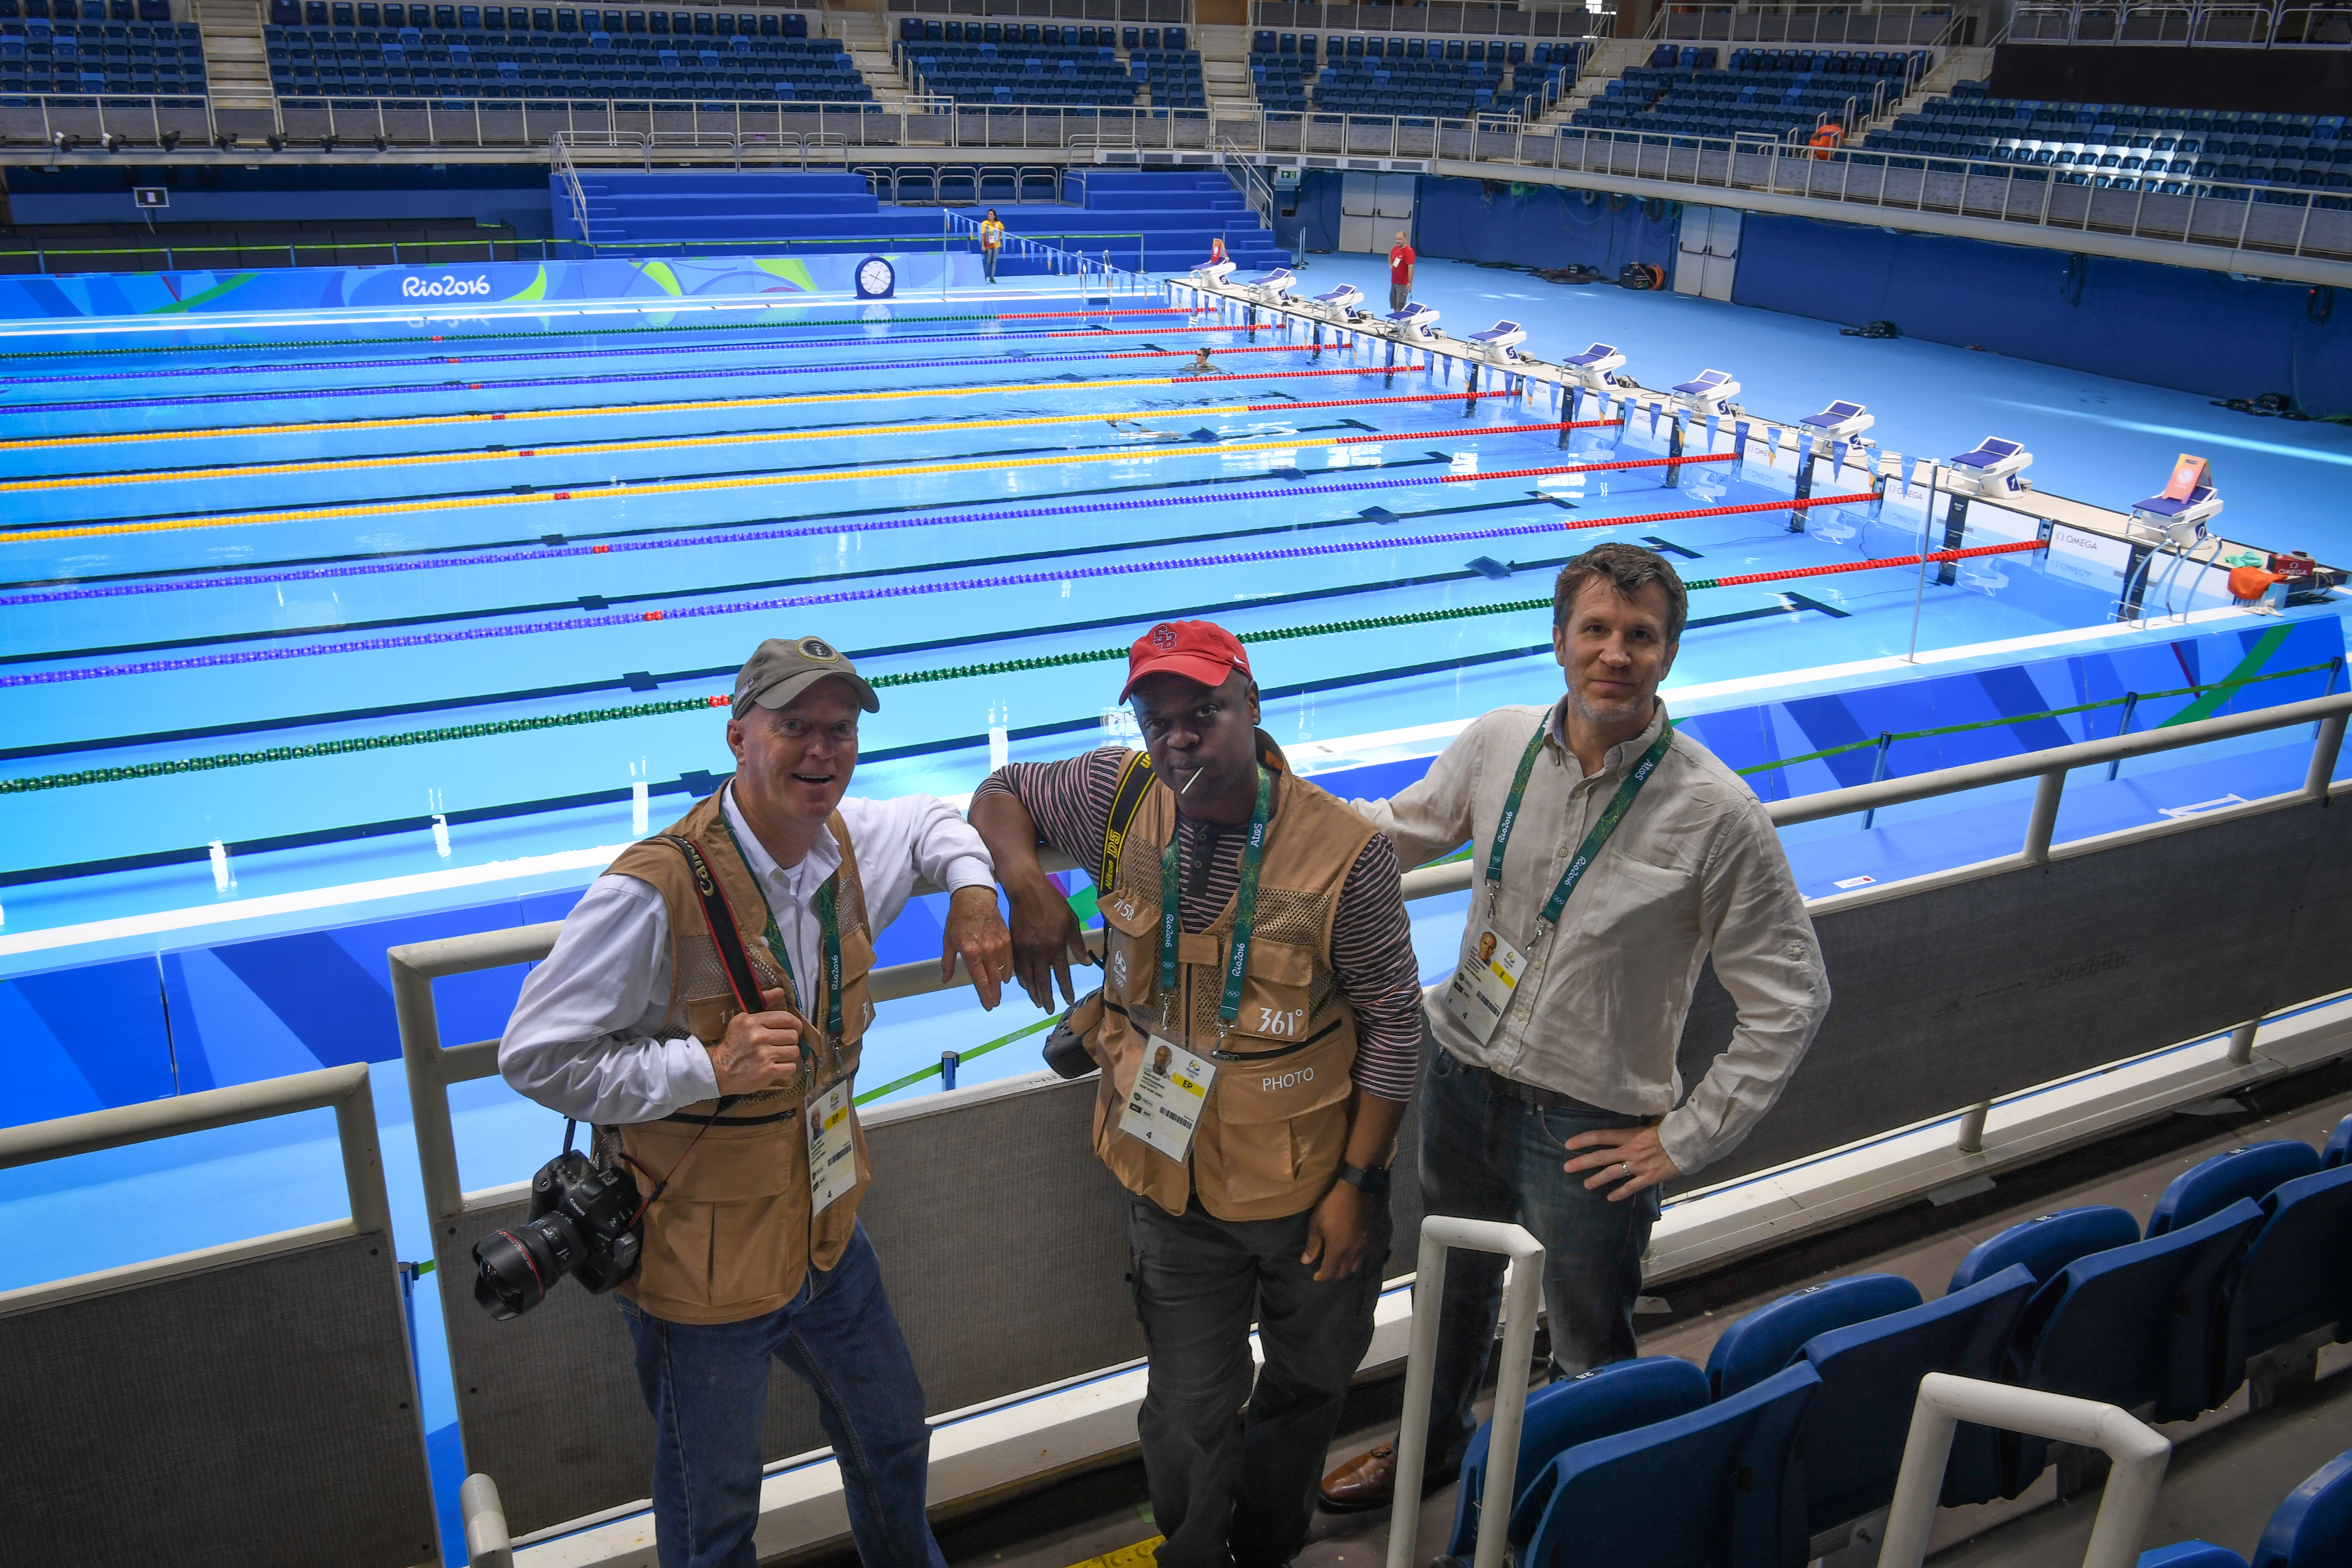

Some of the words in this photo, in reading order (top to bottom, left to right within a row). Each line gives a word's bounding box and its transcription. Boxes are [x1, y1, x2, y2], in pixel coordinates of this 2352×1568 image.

[403, 275, 490, 297] Rio2016
[1423, 327, 1428, 335] 6
[1509, 348, 1514, 357] 5
[1607, 375, 1612, 383] 4
[1720, 404, 1726, 412] 3
[1634, 414, 1651, 424] OMEG
[1853, 437, 1859, 448] 2
[2011, 478, 2015, 489] 1
[1897, 487, 1922, 501] OEGA
[2198, 526, 2205, 539] 0
[2066, 535, 2097, 550] OMEGA
[1634, 759, 1653, 781] Atos
[1497, 811, 1513, 843] Rio2016
[1250, 823, 1263, 847] Atos
[1105, 860, 1114, 890] Nikon
[1564, 856, 1586, 887] Rio2016
[1165, 914, 1174, 947] Rio2016
[1232, 943, 1245, 977] Rio2016
[1182, 1080, 1193, 1089] EP
[1263, 1067, 1314, 1091] PHOTO
[832, 1113, 839, 1124] EP
[569, 1197, 585, 1217] Canon
[1575, 1371, 1595, 1379] 28
